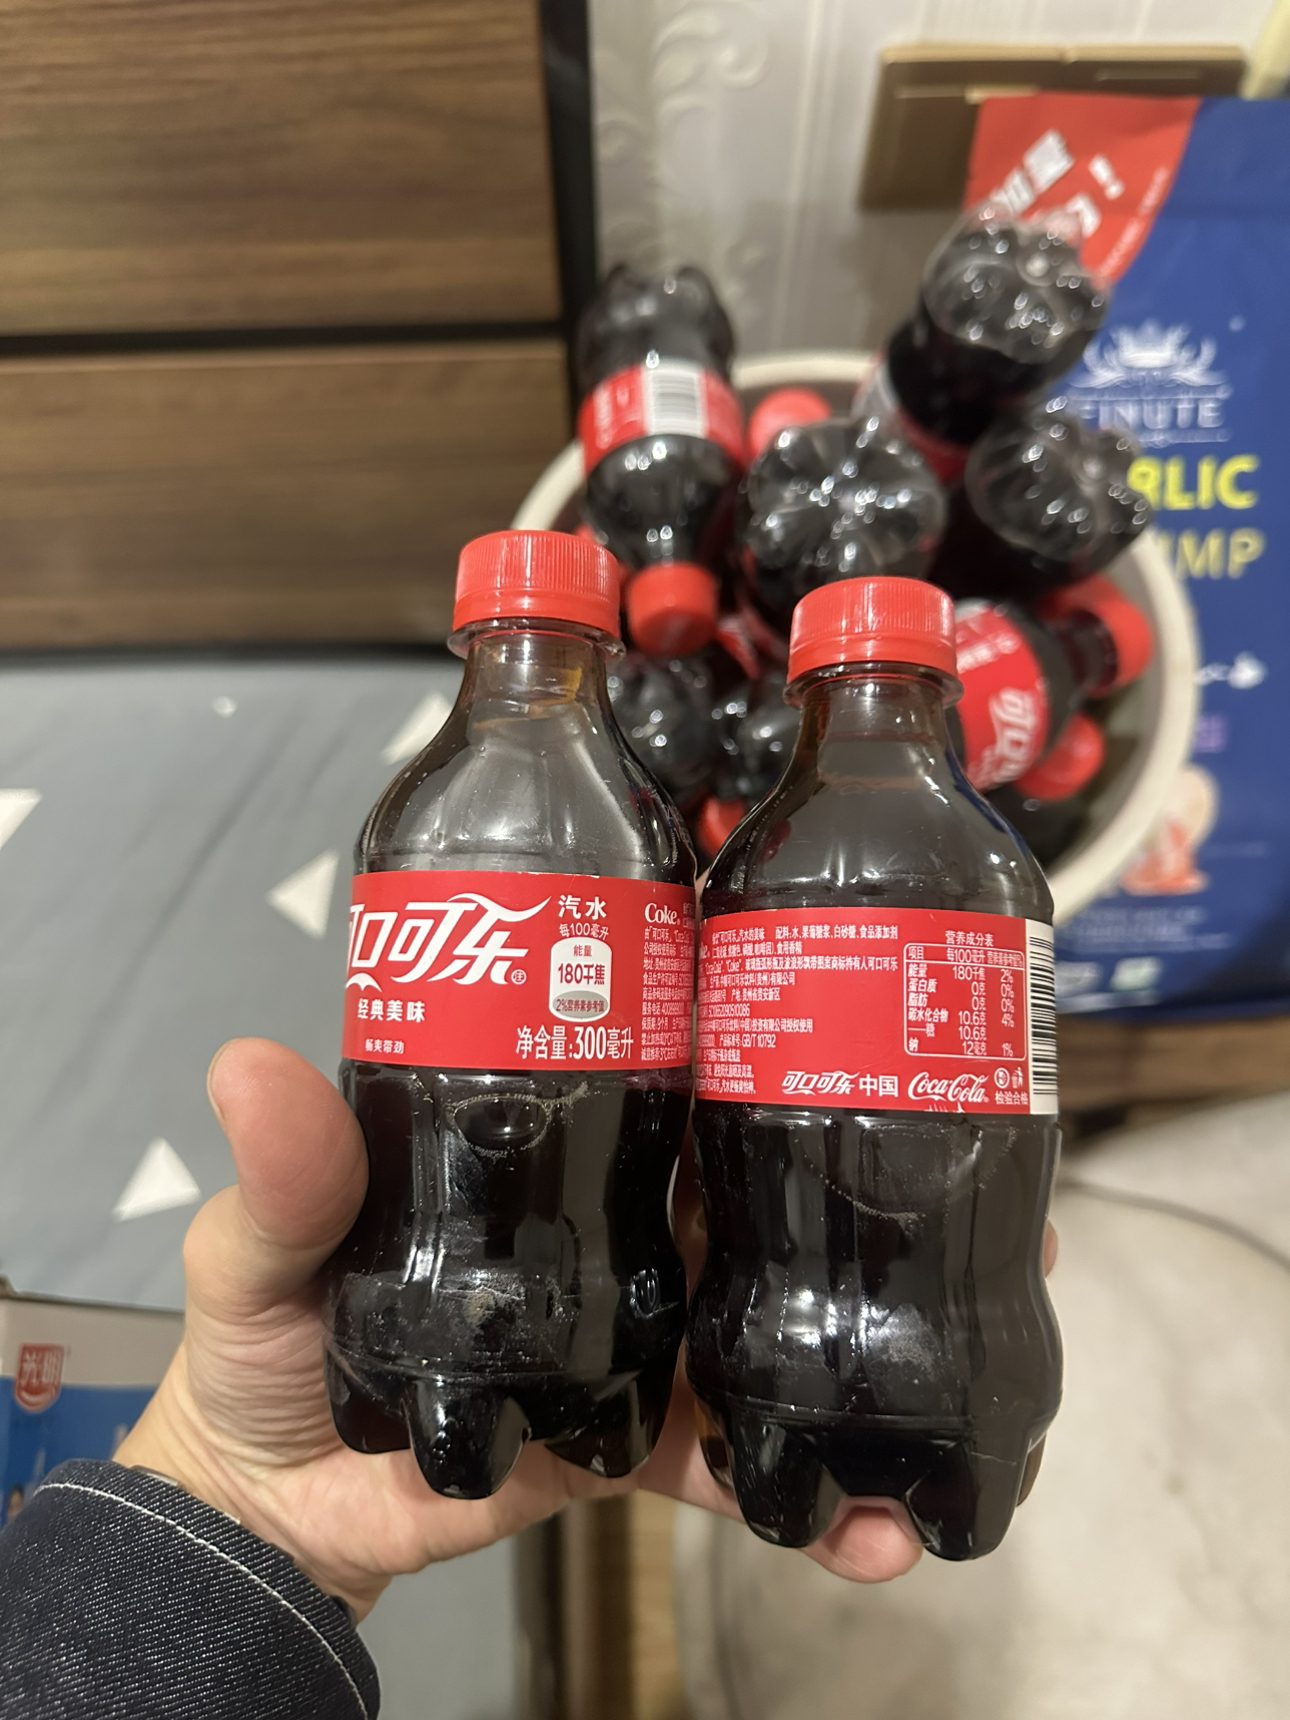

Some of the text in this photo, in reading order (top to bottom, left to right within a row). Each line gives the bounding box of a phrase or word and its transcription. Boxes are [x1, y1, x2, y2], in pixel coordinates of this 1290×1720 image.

[557, 894, 607, 920] 汽水
[644, 902, 679, 925] Coke
[559, 923, 610, 940] 每100毫升
[945, 930, 994, 947] 营养成分表
[573, 944, 593, 957] 能量
[907, 946, 924, 960] 项目
[557, 963, 606, 985] 180千焦
[907, 963, 1014, 984] 能量 180千焦 2%
[907, 978, 937, 993] 蛋白质
[1000, 984, 1014, 999] 0%
[357, 998, 425, 1022] 经典美味
[907, 993, 928, 1008] 脂肪
[1001, 998, 1015, 1013] 0%
[907, 1008, 1015, 1028] 碳水化合物 10.6克 4%
[516, 1024, 634, 1060] 净含量:300毫升
[958, 1026, 987, 1041] 10.6克
[907, 1037, 919, 1052] 钠
[782, 1070, 860, 1096] 可口可乐
[859, 1075, 899, 1098] 中国
[907, 1071, 990, 1102] Coca-Cola
[995, 1090, 1028, 1105] 检验合格
